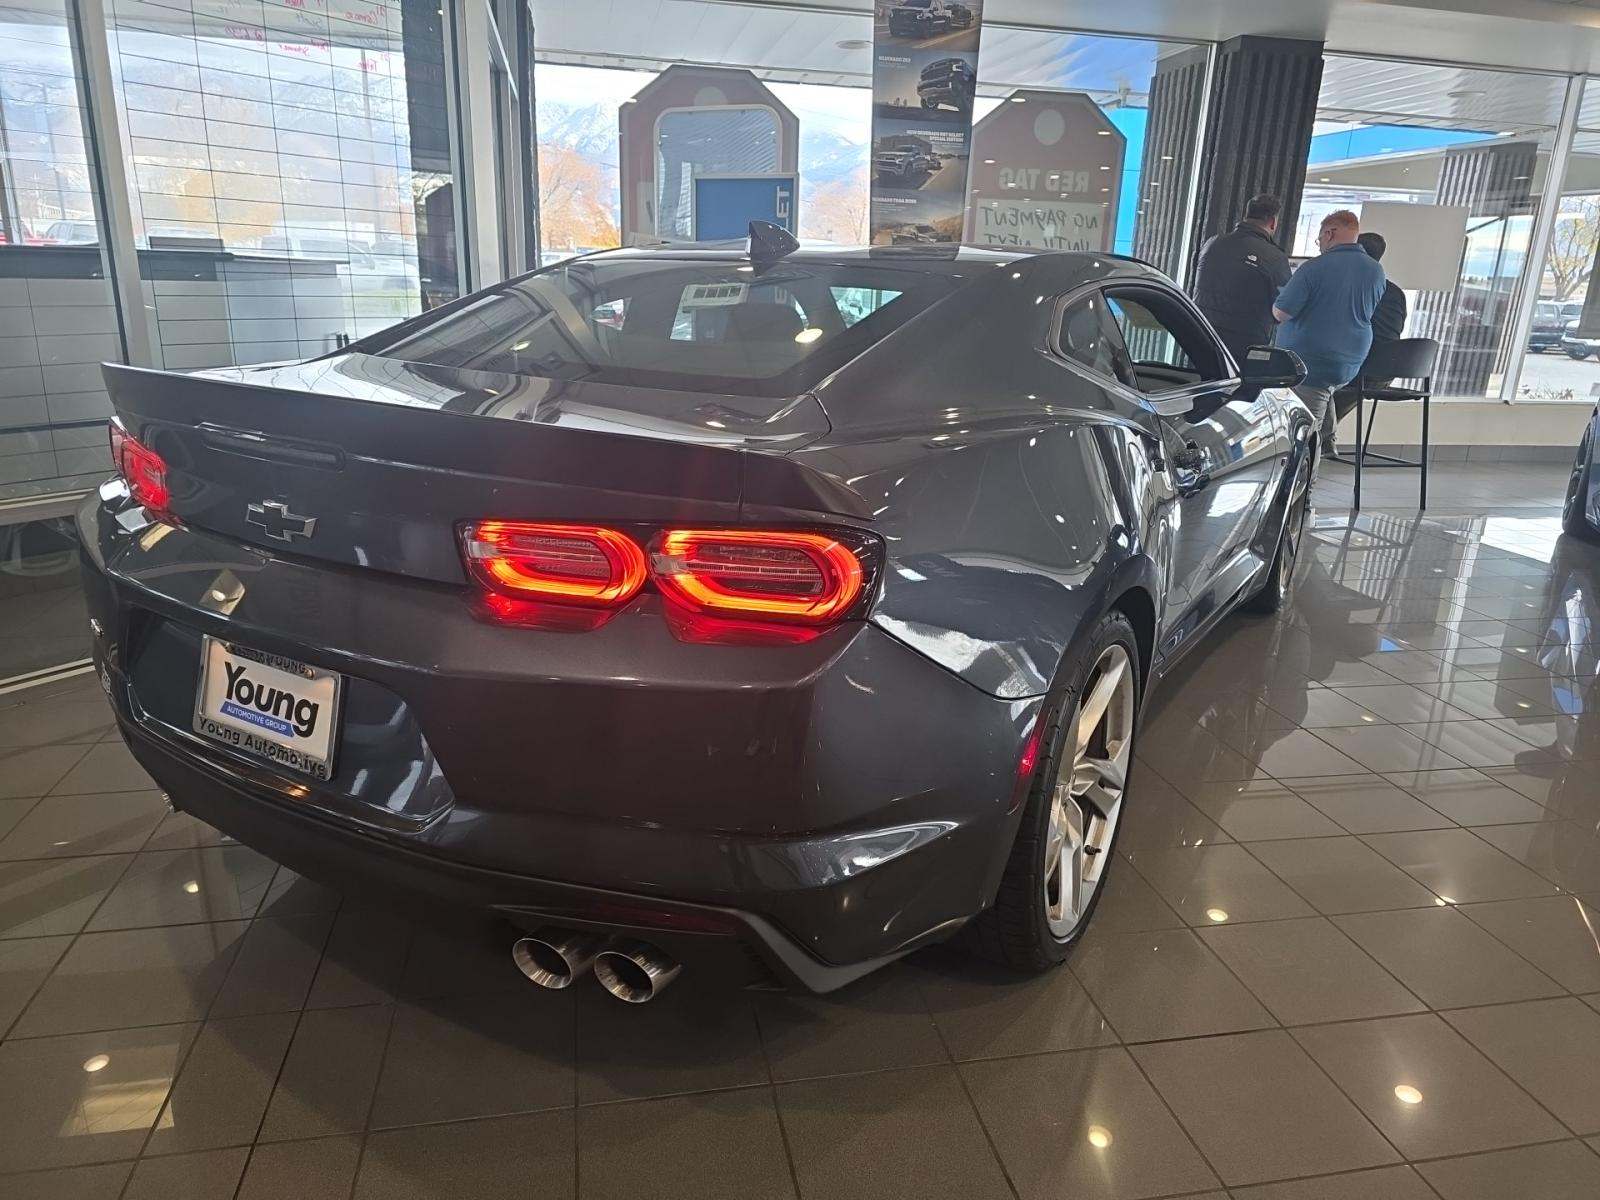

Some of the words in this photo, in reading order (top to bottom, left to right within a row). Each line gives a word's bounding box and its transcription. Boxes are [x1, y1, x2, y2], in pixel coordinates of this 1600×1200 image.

[224, 661, 320, 738] Young
[226, 705, 265, 724] AUTOMOTIVE
[265, 717, 287, 731] GROUP
[199, 717, 241, 745] Young
[244, 735, 326, 776] Automotive
